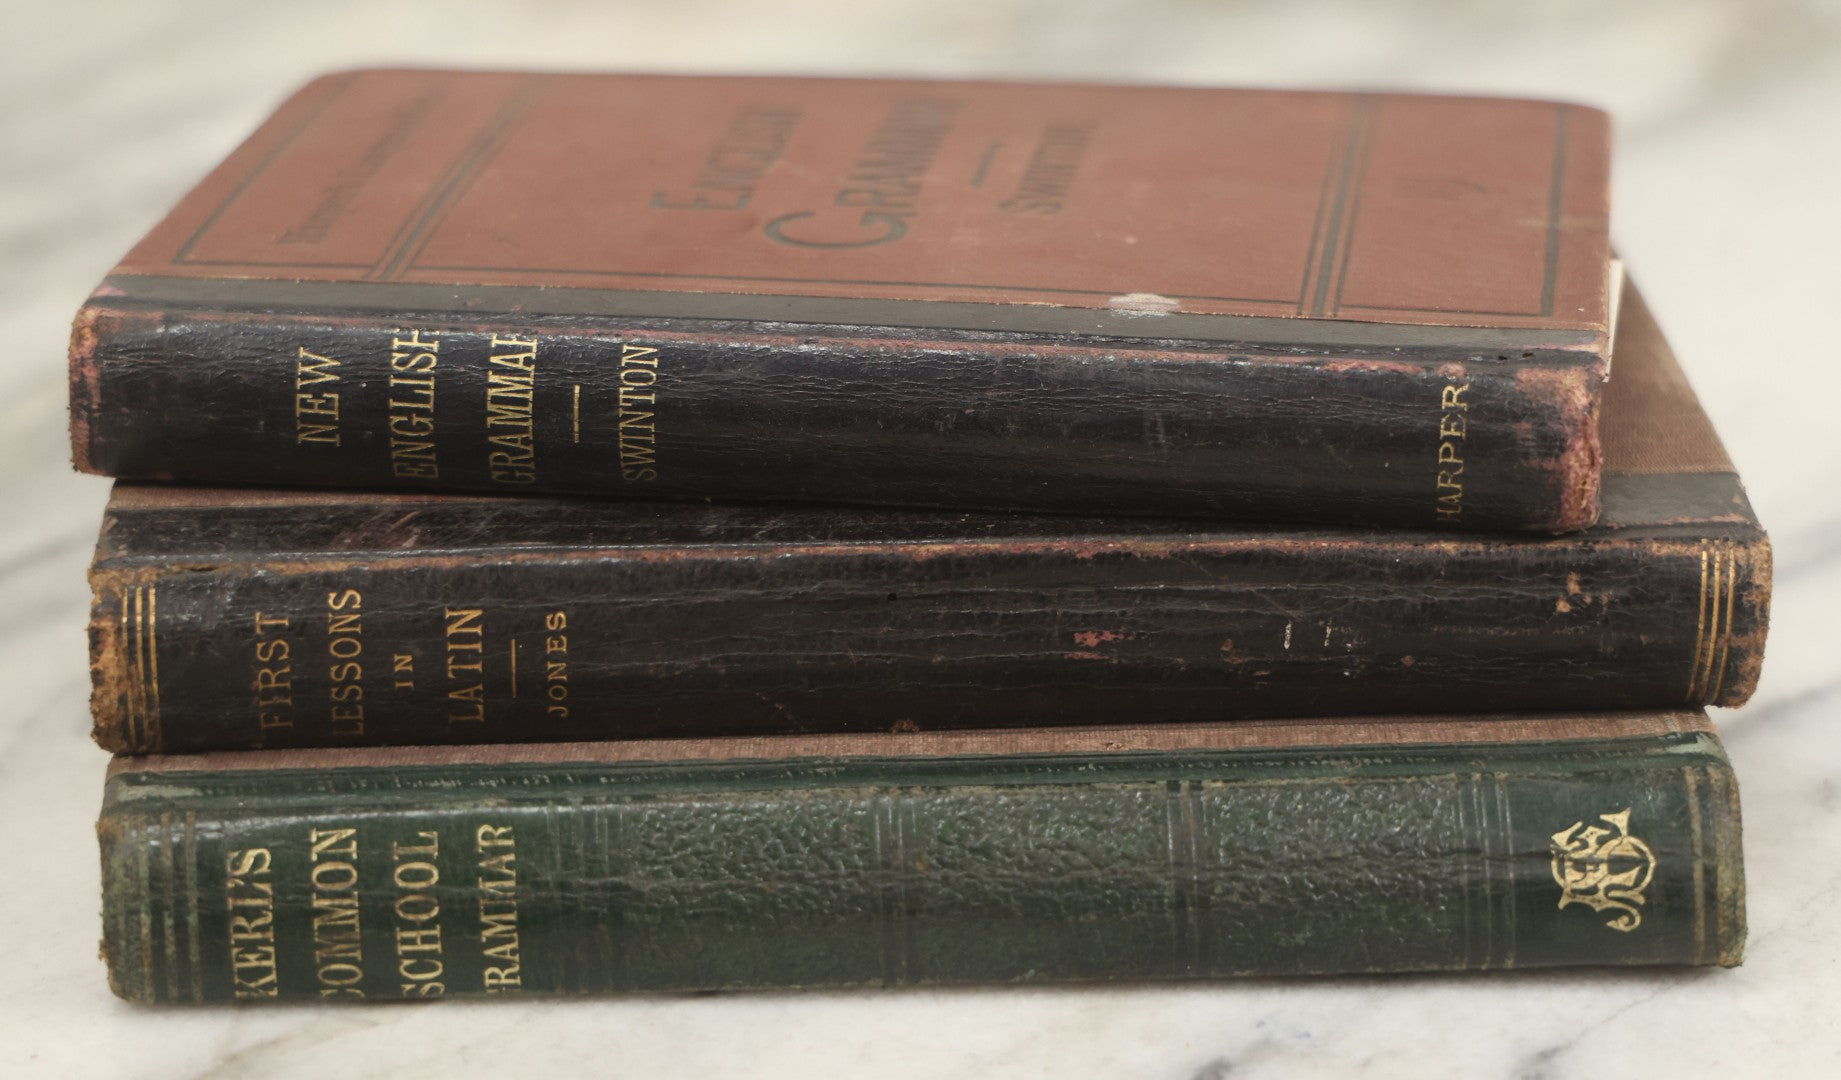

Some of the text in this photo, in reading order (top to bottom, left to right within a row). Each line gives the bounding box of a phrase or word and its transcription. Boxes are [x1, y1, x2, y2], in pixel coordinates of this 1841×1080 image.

[296, 347, 341, 447] NEW
[619, 343, 659, 482] SWINTON
[255, 611, 293, 729] FIRST
[328, 589, 365, 736] LESSONS
[394, 653, 414, 689] IN
[446, 607, 484, 722] LATIN
[546, 610, 569, 718] JONES
[227, 848, 277, 997] KERL'S
[477, 824, 521, 992] RAMMAR
